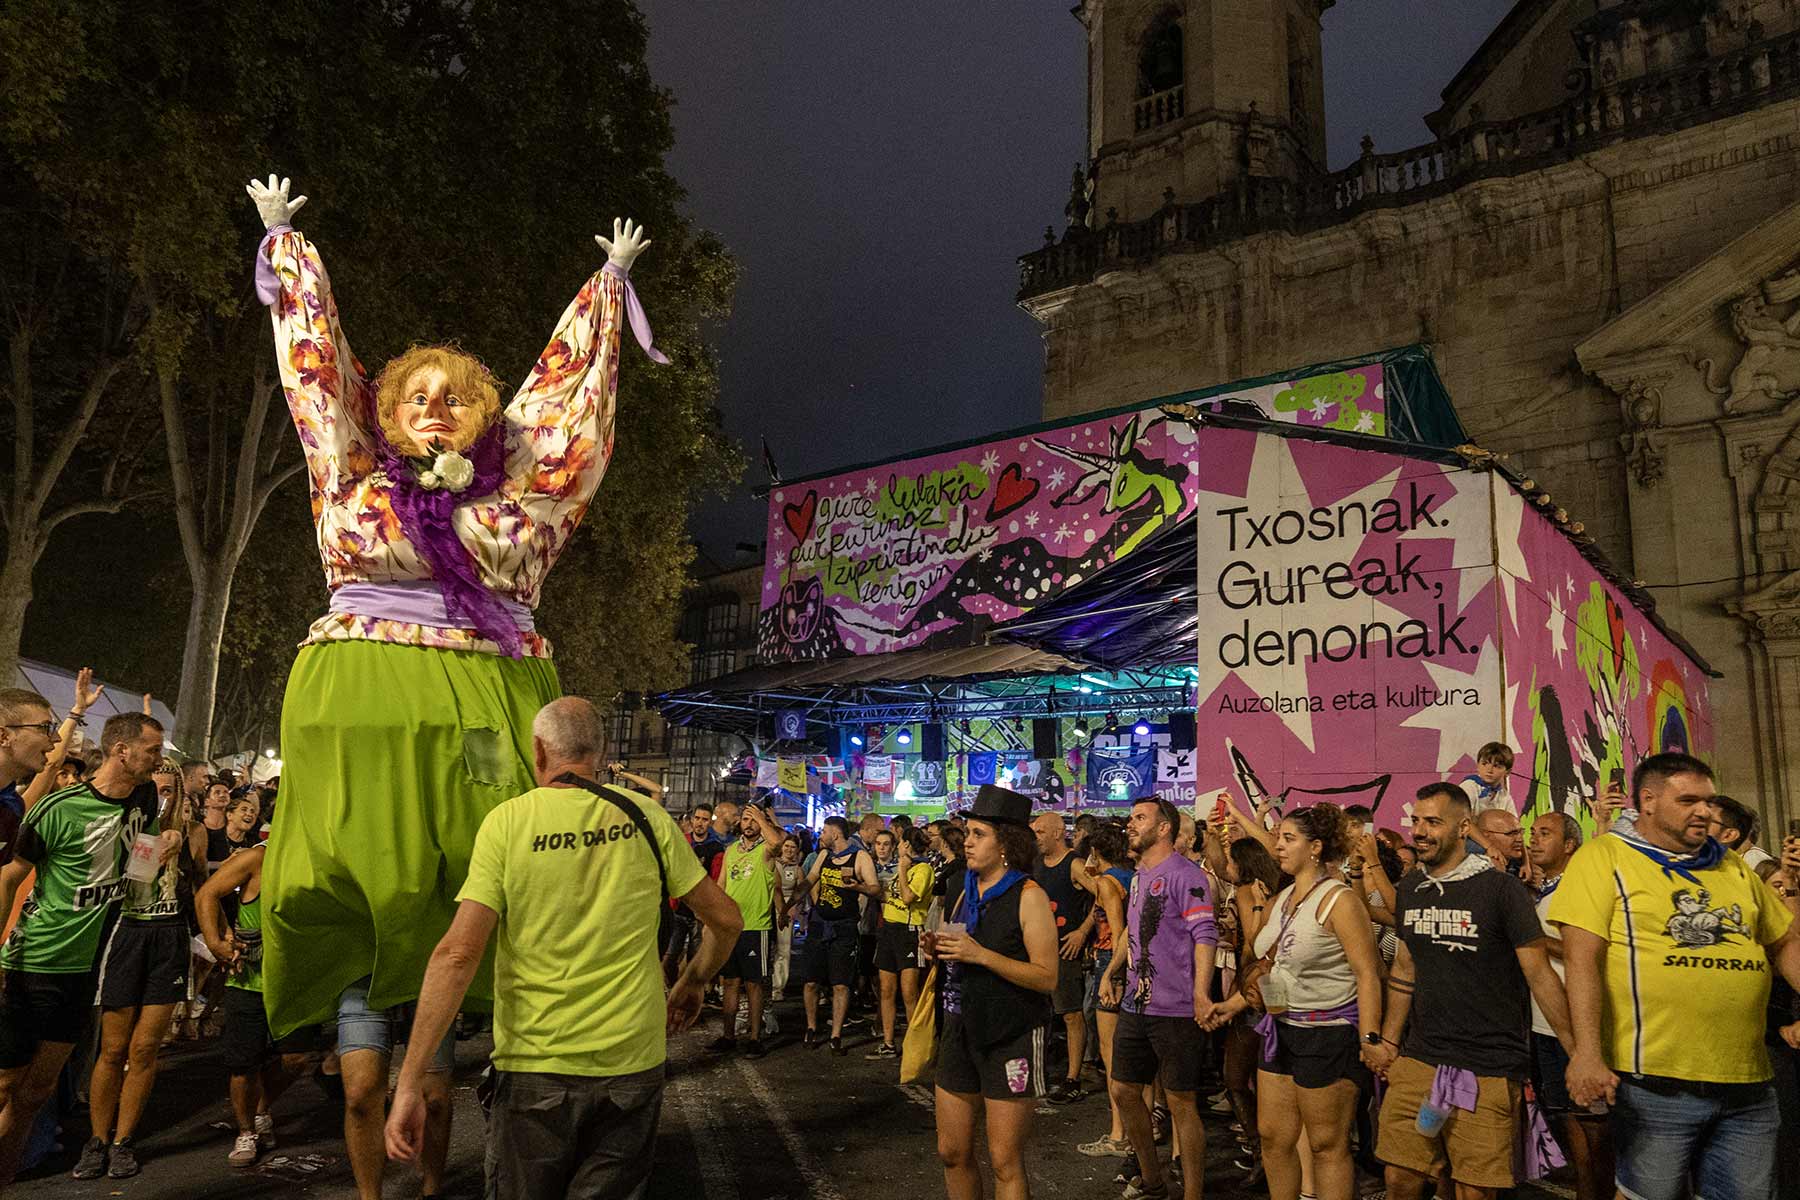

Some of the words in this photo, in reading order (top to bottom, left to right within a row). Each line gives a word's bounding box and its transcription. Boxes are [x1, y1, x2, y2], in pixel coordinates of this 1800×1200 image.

[816, 496, 879, 537] gure
[1216, 482, 1450, 552] Txosnak.
[1217, 542, 1444, 610] Gureak,
[1218, 603, 1480, 670] denonak.
[1218, 690, 1325, 714] Auzolana
[1332, 691, 1377, 711] eta
[1386, 685, 1481, 708] kultura
[532, 832, 577, 852] HOR
[1662, 954, 1767, 973] SATORRAK
